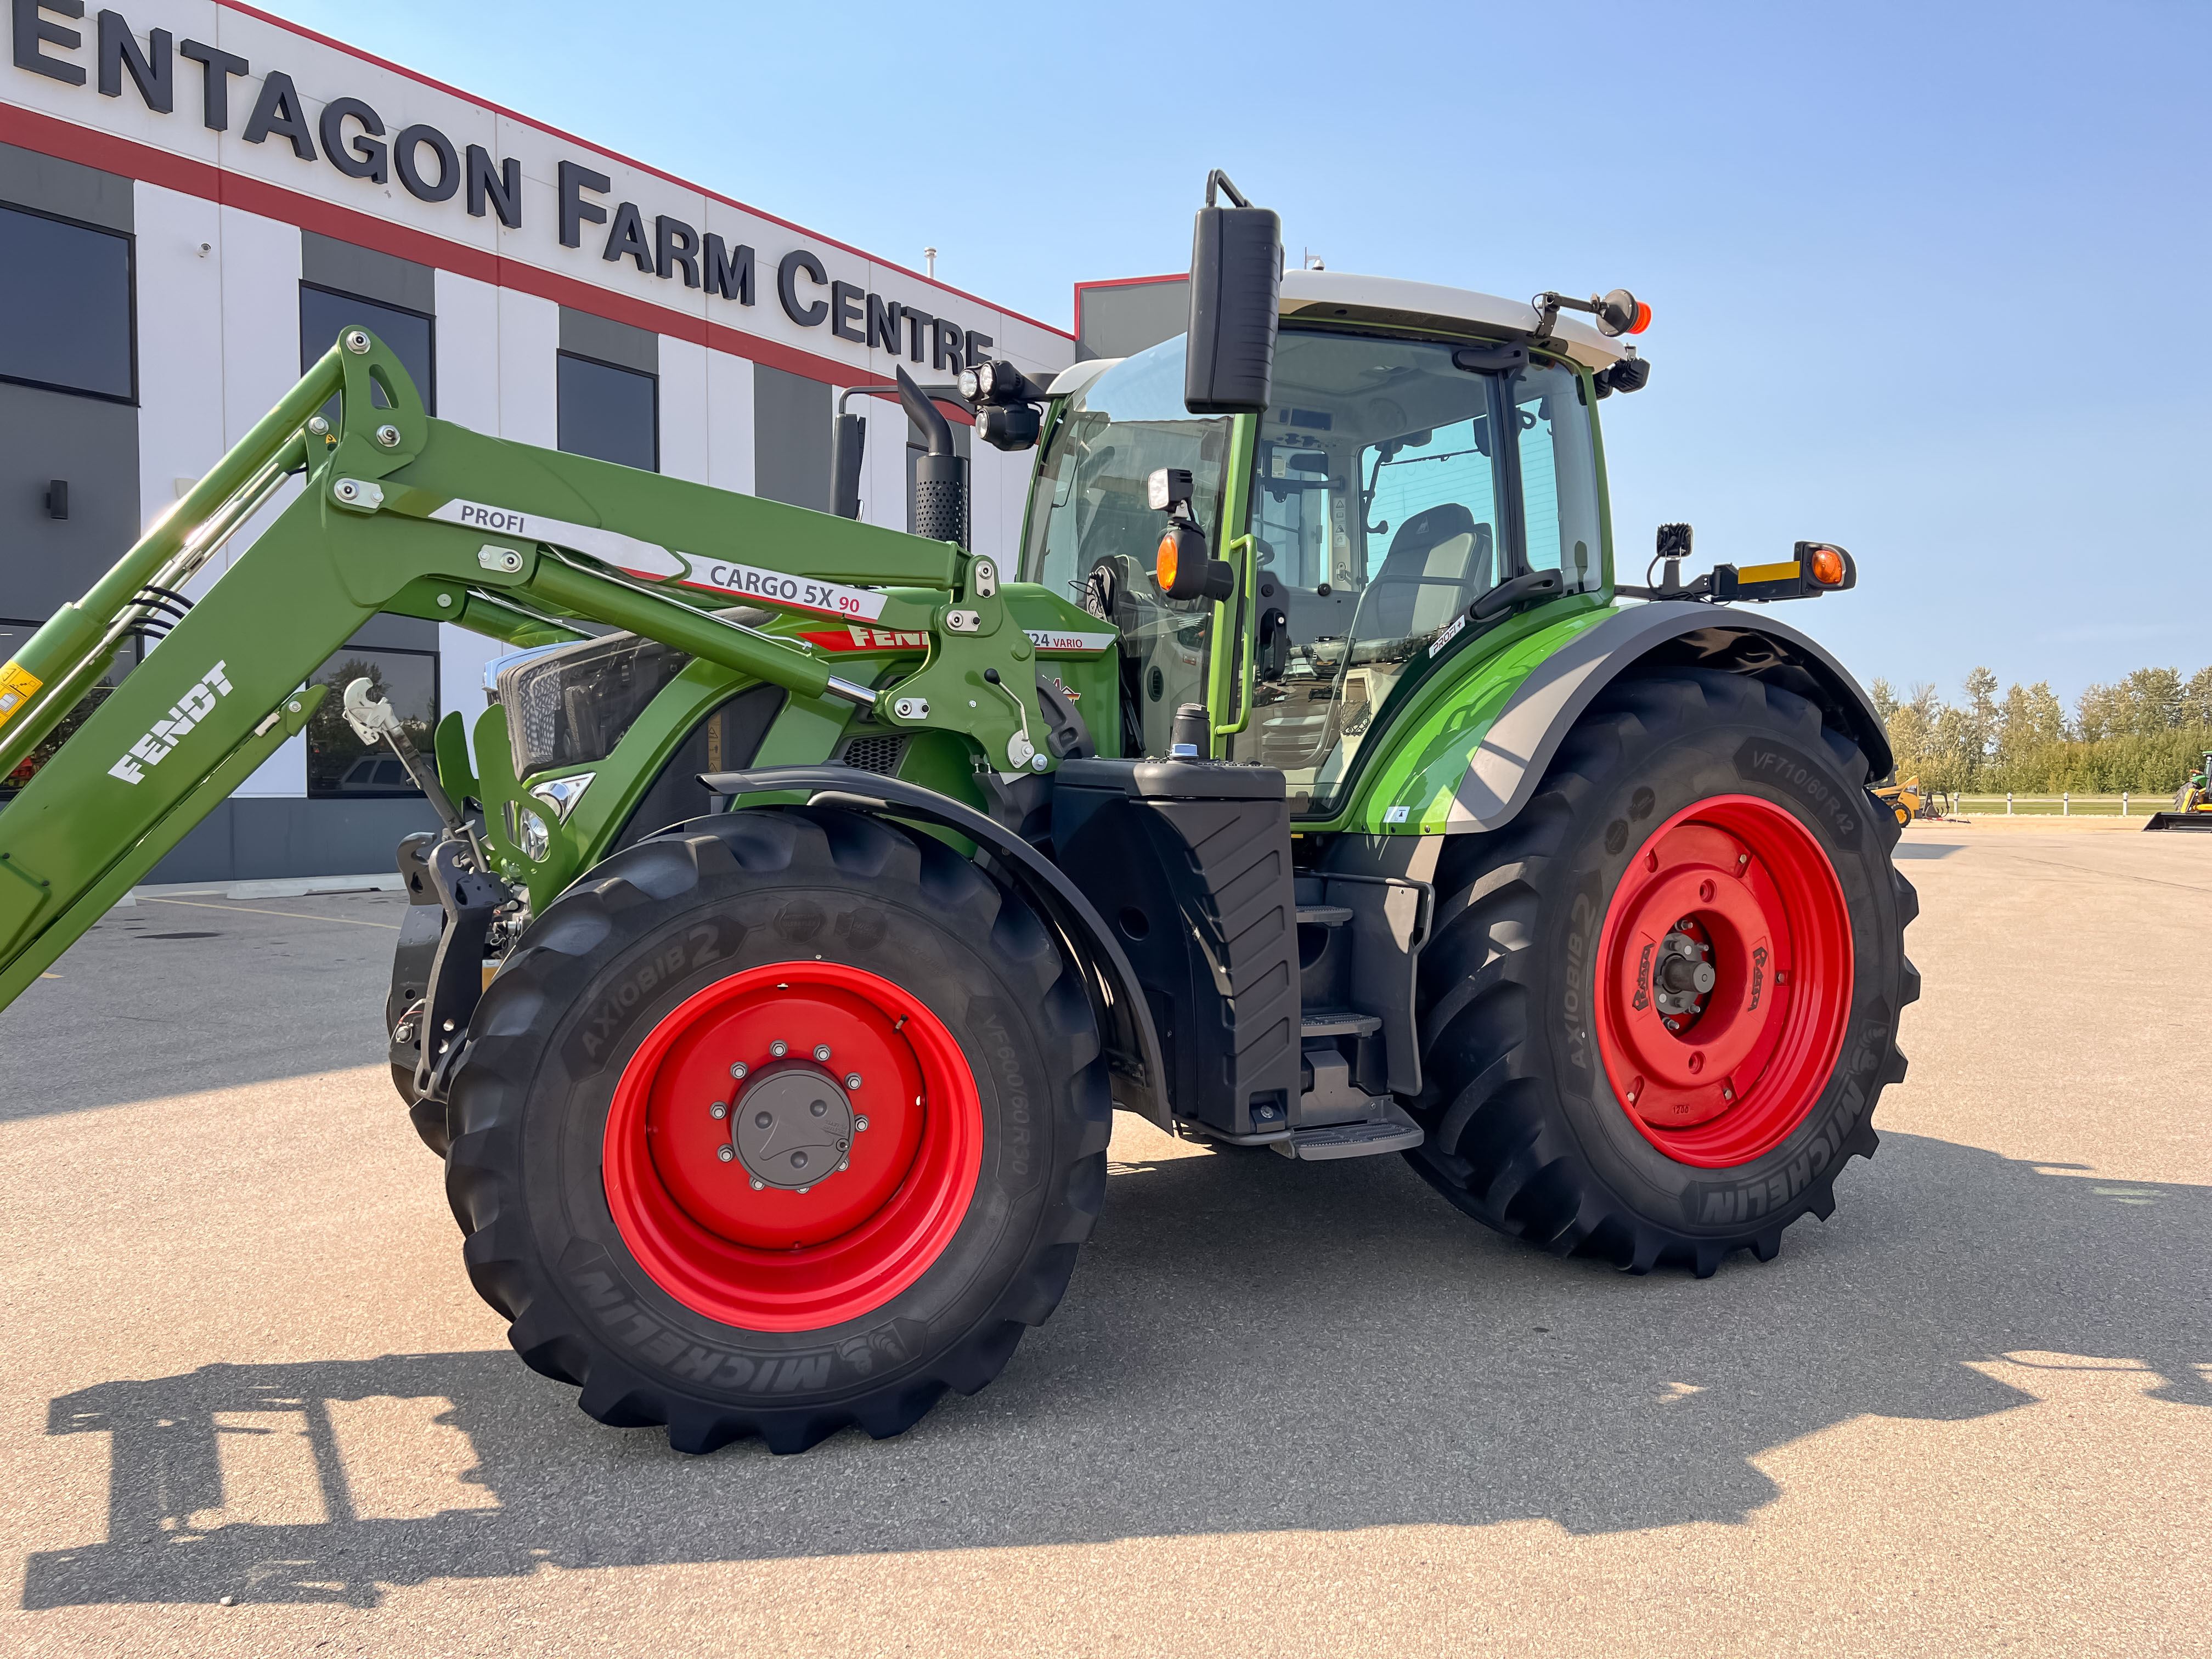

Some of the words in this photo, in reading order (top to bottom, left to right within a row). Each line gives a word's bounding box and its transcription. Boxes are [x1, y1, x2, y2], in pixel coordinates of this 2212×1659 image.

[12, 0, 522, 229] ENTAGON
[558, 160, 755, 307] FARM
[460, 505, 525, 533] PROFI
[710, 566, 798, 600] CARGO
[803, 584, 834, 608] 5X
[839, 596, 860, 613] 90
[847, 624, 929, 647] FEN
[1053, 637, 1083, 648] VARIO
[1433, 625, 1456, 653] PROFI
[107, 659, 233, 785] FENDT
[1571, 892, 1597, 939] 2
[582, 945, 686, 1058] AXIOBIB
[688, 924, 720, 969] 2
[1564, 933, 1587, 1069] AXIOBIB
[1673, 1105, 1689, 1114] 1200
[1700, 1079, 1865, 1223] MICHELIN
[569, 1270, 832, 1392] MICHELIN
